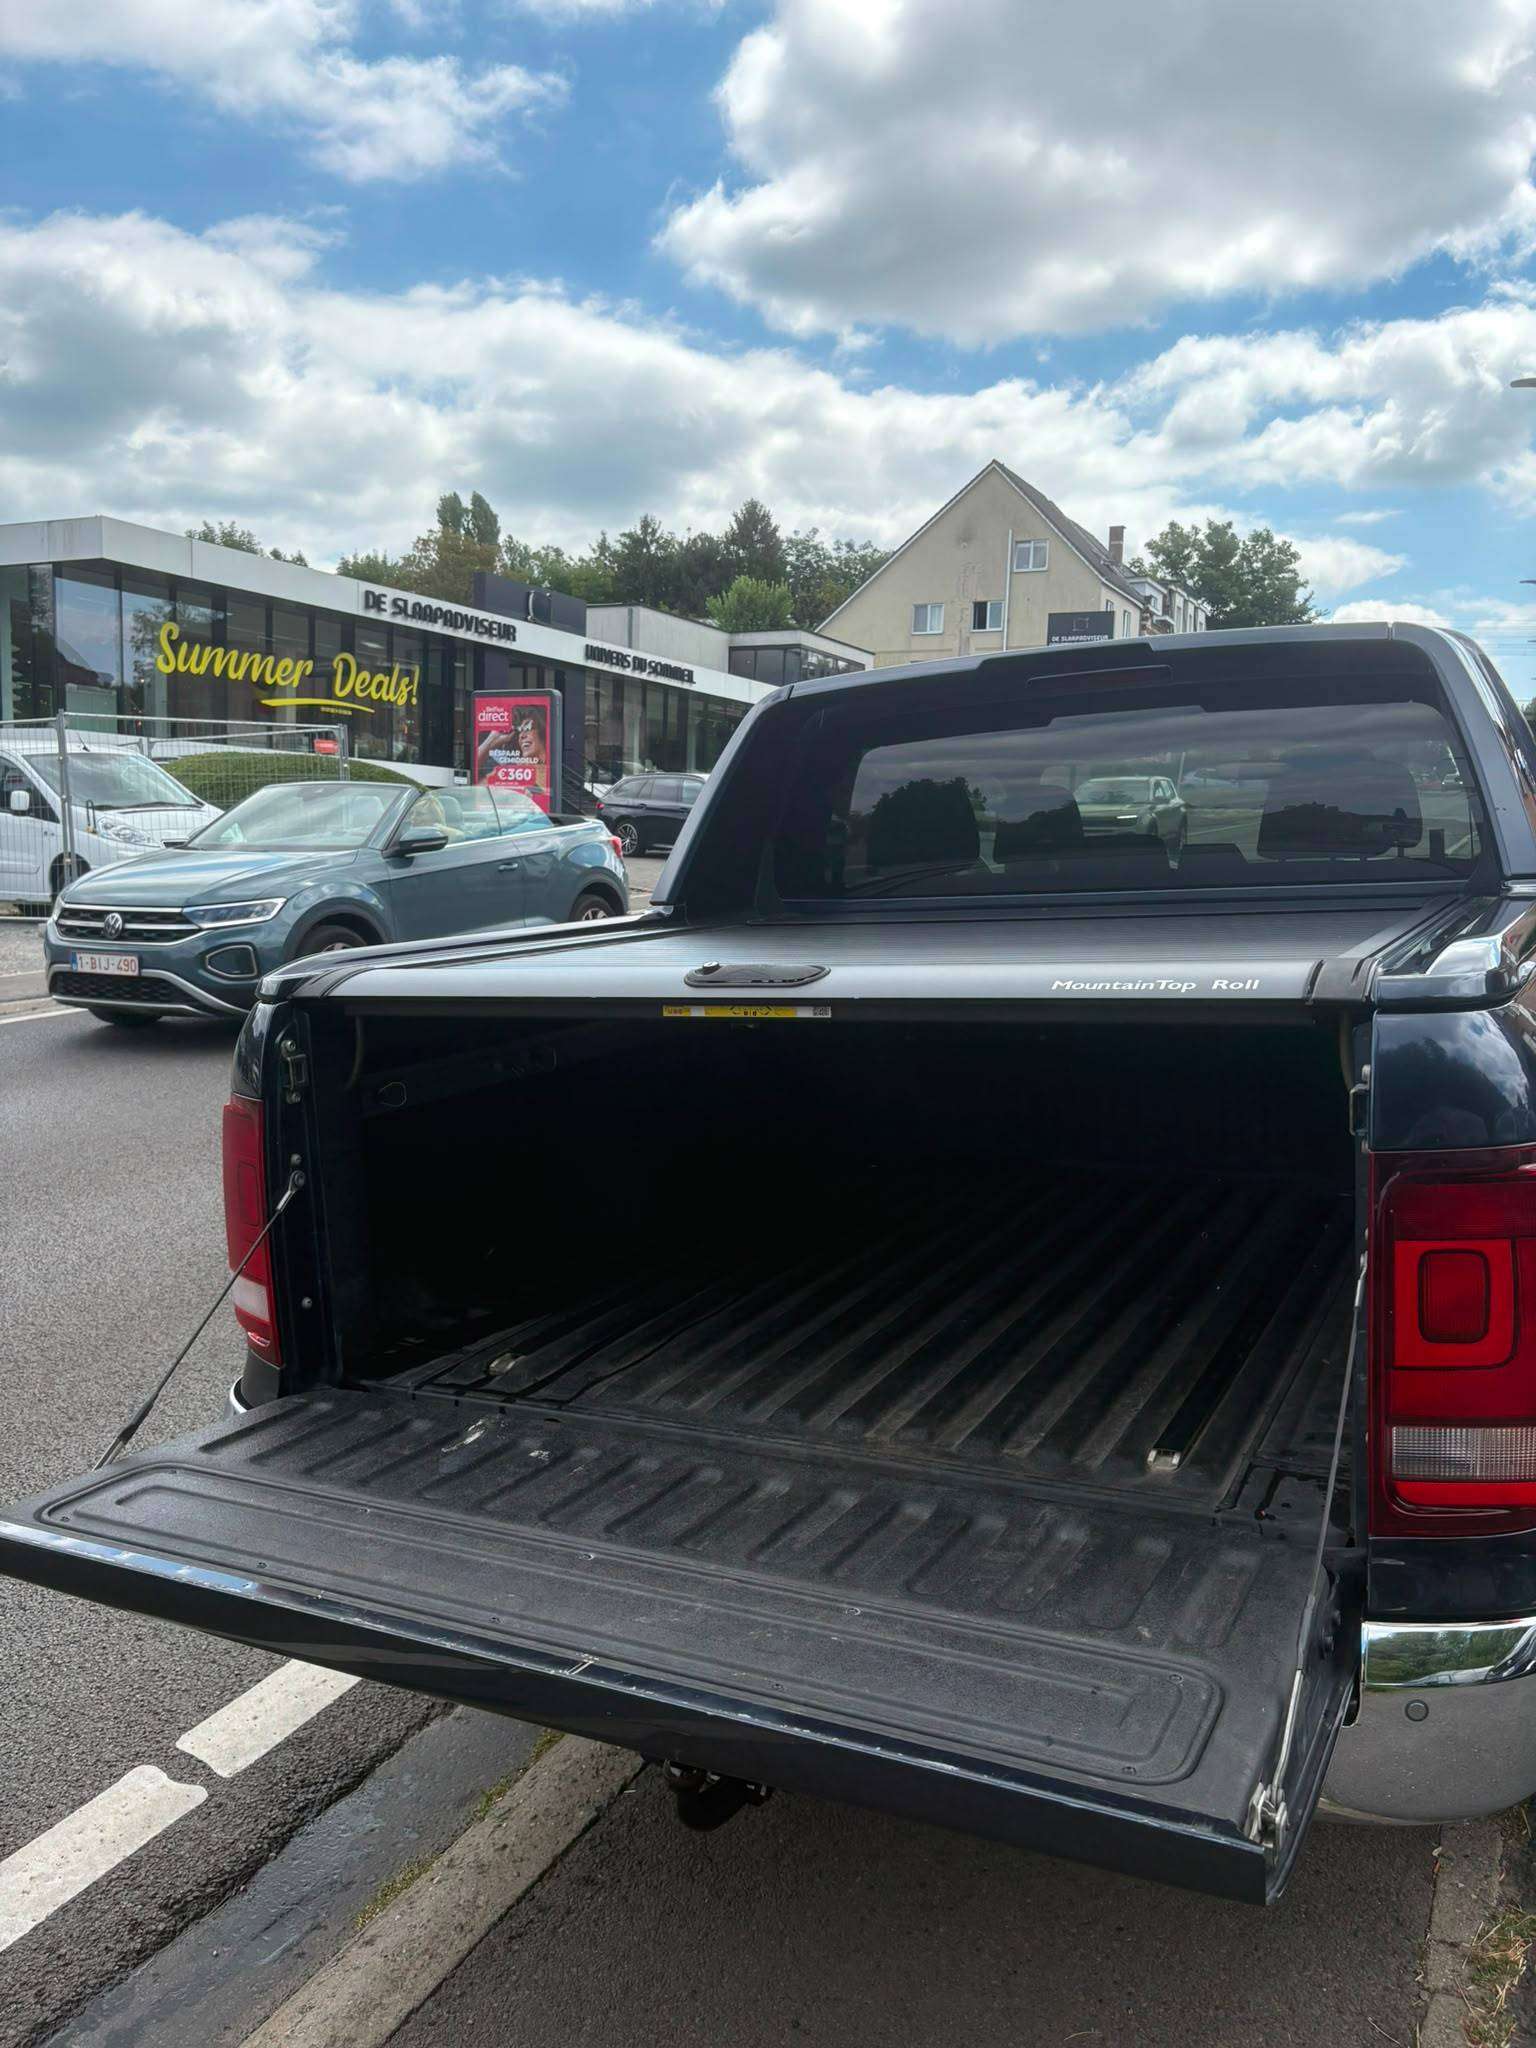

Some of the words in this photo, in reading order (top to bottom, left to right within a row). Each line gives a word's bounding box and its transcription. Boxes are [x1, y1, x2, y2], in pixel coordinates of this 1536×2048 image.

[364, 590, 387, 613] DE
[391, 597, 517, 643] SLAAPADVISEUR
[156, 621, 314, 689] Summer
[332, 652, 421, 706] Deals!
[585, 643, 632, 669] UNIVERS
[631, 655, 648, 673] DU
[647, 660, 697, 684] SOMMEIL
[478, 710, 509, 722] direct
[489, 749, 521, 757] BESPAAR
[78, 956, 137, 972] 1-BIJ-490
[1051, 979, 1197, 993] MountainTop
[1211, 979, 1261, 991] Roll
